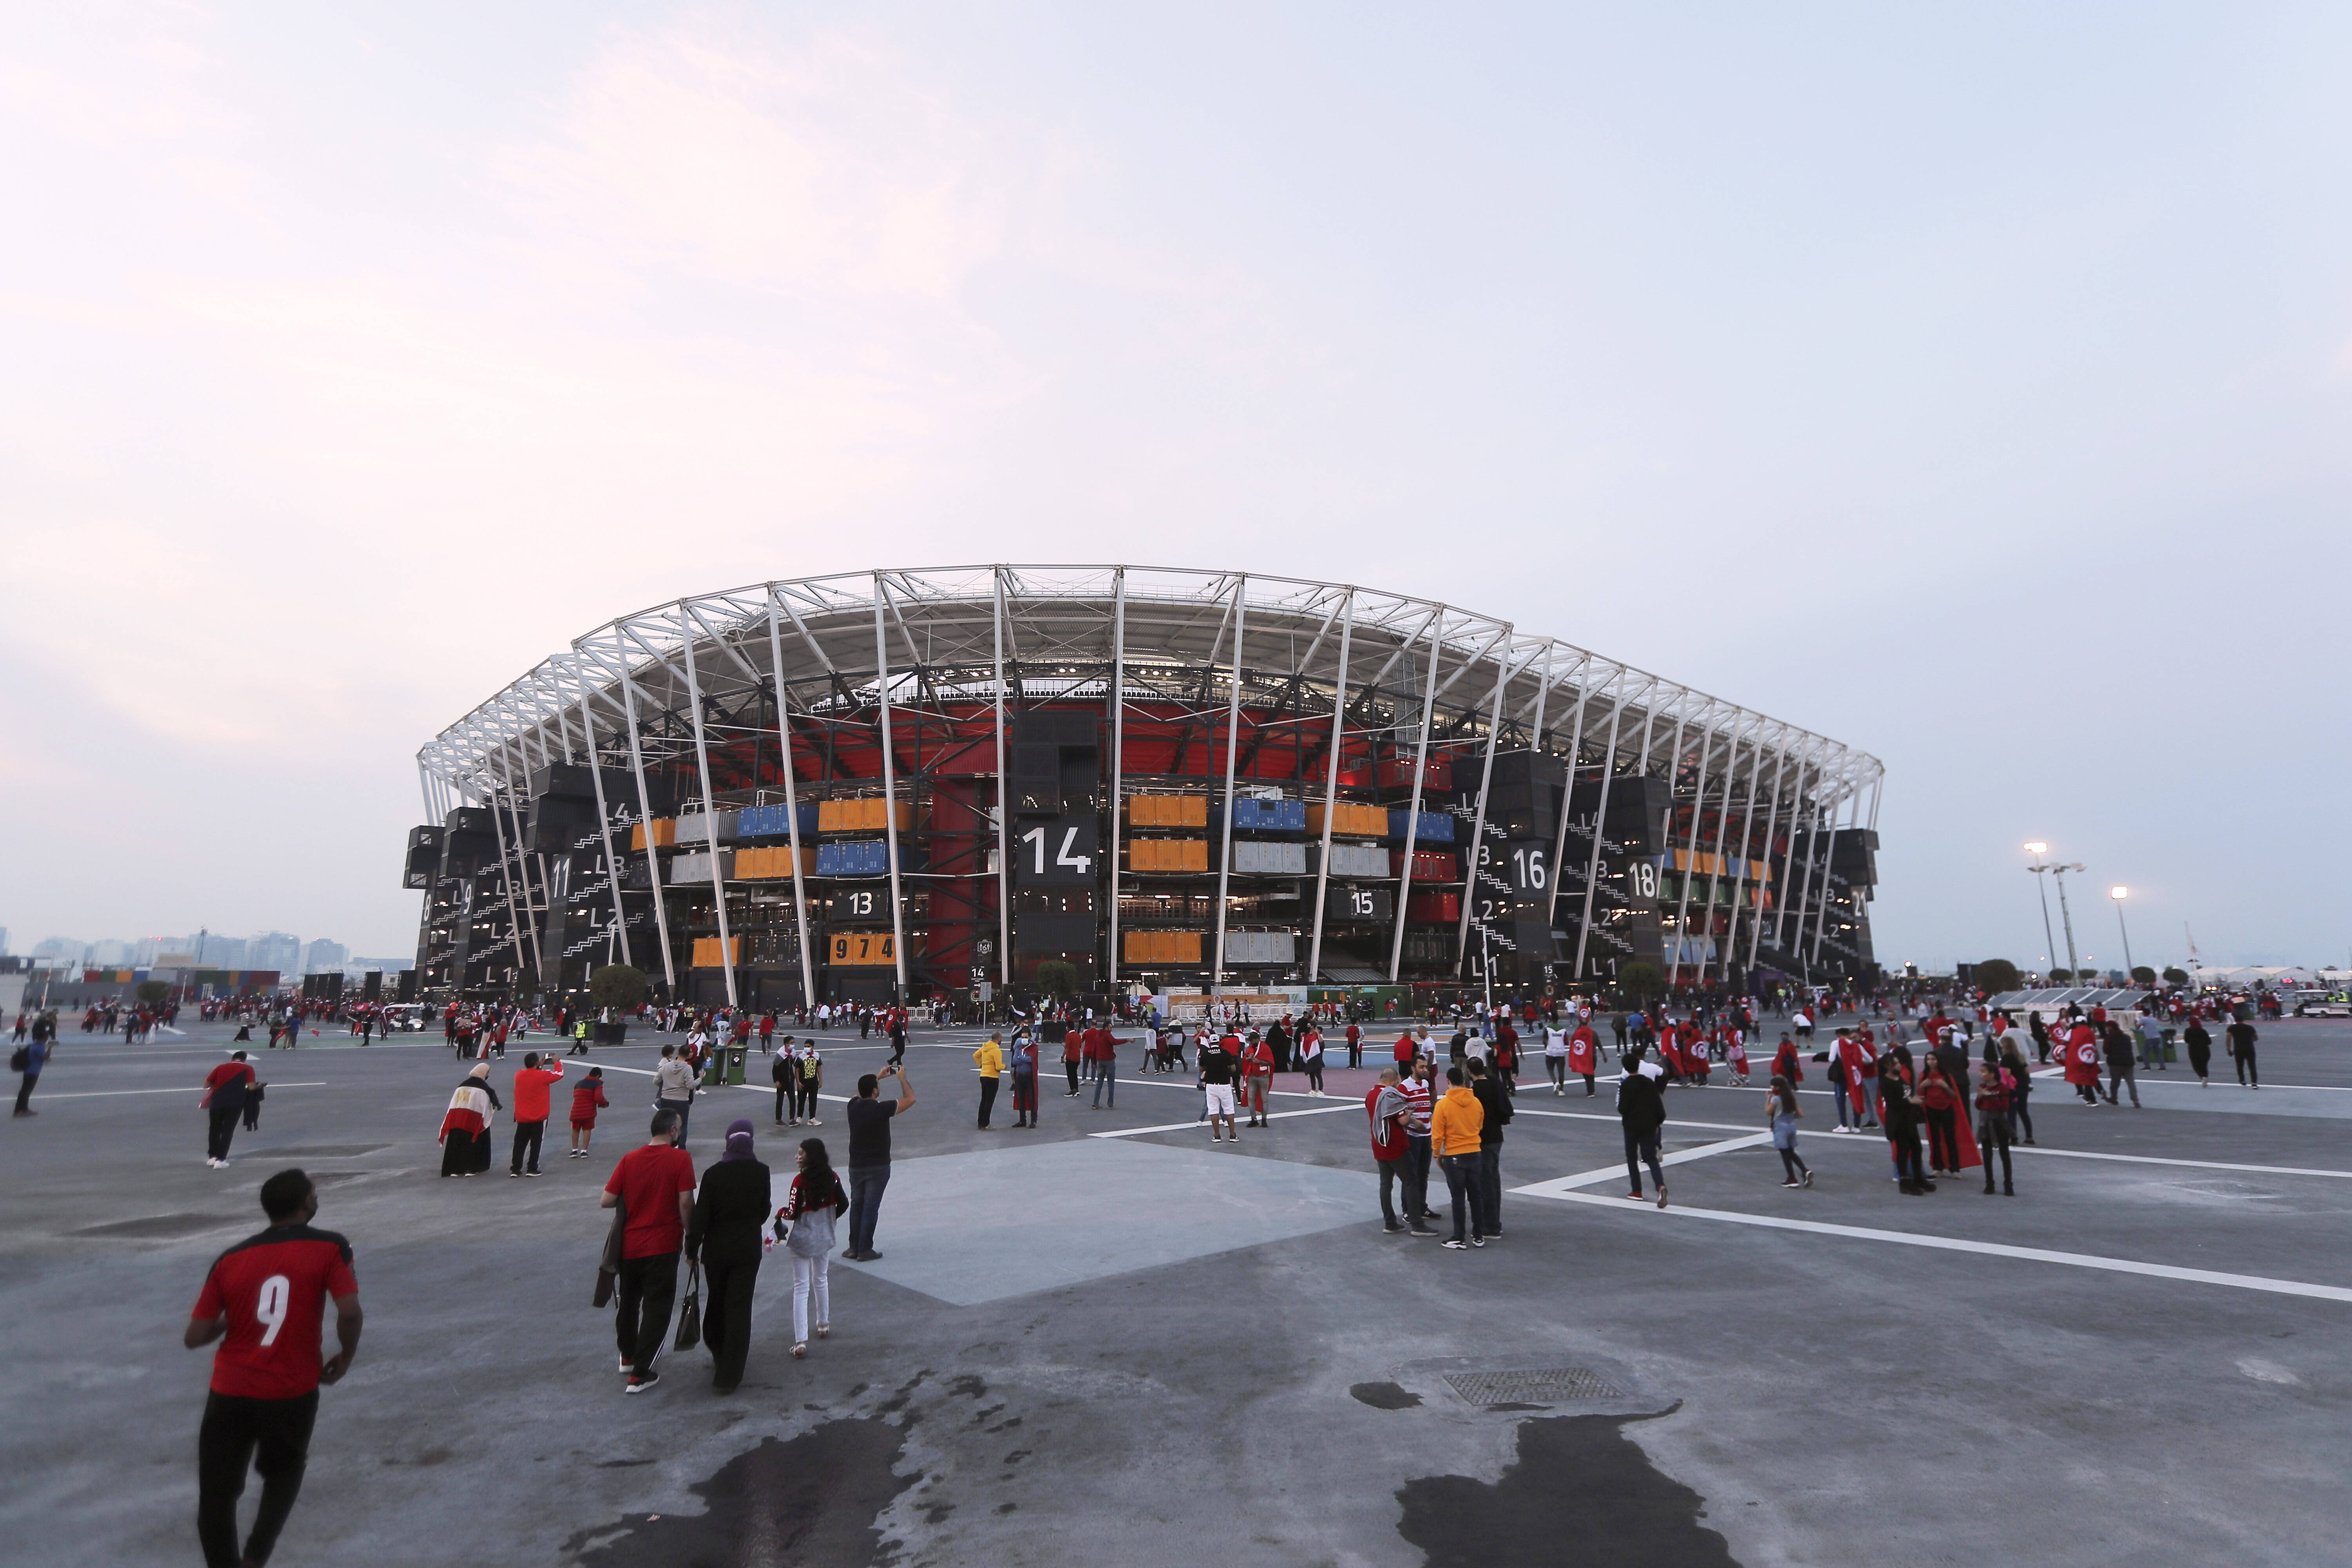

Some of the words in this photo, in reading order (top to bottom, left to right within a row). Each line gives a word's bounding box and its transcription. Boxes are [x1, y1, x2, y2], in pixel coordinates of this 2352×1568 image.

[1022, 827, 1091, 874] 14
[595, 855, 625, 875] L3
[1514, 849, 1546, 889] 16
[496, 880, 521, 897] L3
[554, 858, 570, 898] 11
[1629, 862, 1655, 898] 18
[424, 894, 431, 921] 8
[463, 884, 472, 915] 9
[849, 892, 873, 914] 13
[1351, 893, 1374, 914] 15
[1471, 900, 1494, 920] L2
[1852, 891, 1867, 917] 21
[590, 908, 619, 928] L2
[491, 923, 516, 939] L2
[486, 966, 512, 983] L1
[972, 968, 984, 977] 14
[1472, 956, 1497, 976] L1
[1592, 957, 1615, 975] L1
[257, 1275, 290, 1346] 9
